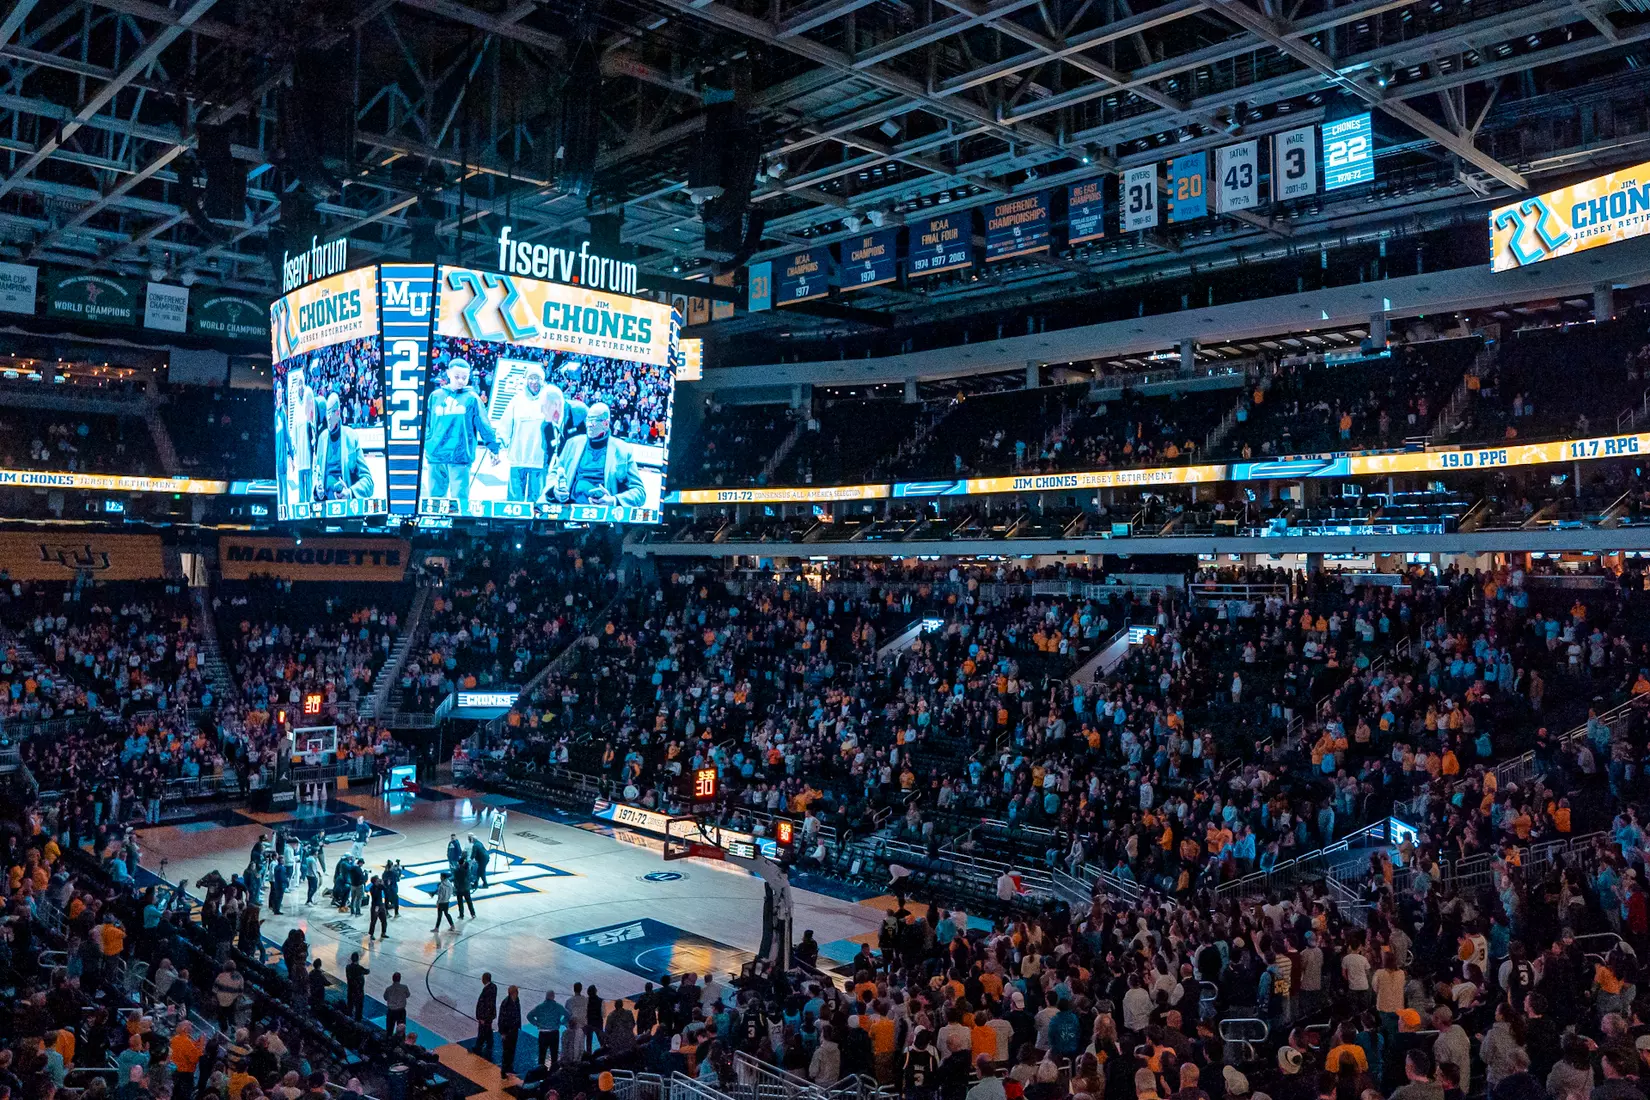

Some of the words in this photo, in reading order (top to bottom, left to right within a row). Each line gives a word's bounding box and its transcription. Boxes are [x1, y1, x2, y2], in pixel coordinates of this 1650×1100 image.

[1331, 120, 1360, 135] CHONES
[1286, 134, 1304, 145] WADE
[1229, 148, 1249, 159] TATUM
[1329, 136, 1367, 166] 22
[1180, 159, 1199, 171] LUCAS
[1285, 147, 1305, 179] 3
[1131, 170, 1150, 182] RIVERS
[1224, 163, 1253, 190] 43
[1337, 170, 1361, 183] 1970-72
[1073, 187, 1083, 197] BIG
[1083, 183, 1098, 194] EAST
[1177, 174, 1202, 201] 20
[1285, 183, 1308, 194] 2001-03
[1620, 179, 1636, 189] JIM
[1070, 191, 1101, 206] CHAMPIONS
[1129, 182, 1153, 214] 31
[1229, 196, 1250, 206] 1972-76
[995, 197, 1039, 217] CONFERENCE
[931, 219, 949, 232] NCAA
[988, 207, 1046, 230] CHAMPIONSHIPS
[922, 231, 940, 246] FINAL
[941, 228, 958, 241] FOUR
[1496, 197, 1571, 266] 22
[1574, 224, 1612, 239] JERSEY
[863, 236, 873, 248] NIT
[498, 226, 637, 294] fiserv.forum
[795, 253, 810, 265] NCAA
[851, 245, 885, 261] CHAMPIONS
[914, 258, 929, 270] 1974
[931, 255, 946, 266] 1977
[948, 251, 966, 263] 2003
[283, 235, 347, 293] fiserv.forum
[786, 261, 818, 277] CHAMPIONS
[13, 275, 27, 283] CUP
[860, 270, 876, 282] 1970
[752, 277, 768, 299] 31
[795, 286, 810, 297] 1977
[148, 293, 186, 306] CONFERENCE
[385, 280, 428, 317] MU
[595, 300, 610, 309] JIM
[692, 299, 705, 312] 14
[54, 301, 82, 311] WORLD
[85, 304, 131, 317] CHAMPIONS
[149, 302, 184, 313] CHAMPIONS
[299, 289, 361, 333] CHONES
[447, 271, 540, 342] 22
[543, 301, 652, 344] CHONES
[199, 320, 225, 331] WORLD
[226, 324, 267, 336] CHAMPIONS
[321, 321, 363, 338] RETIREMENT
[542, 332, 583, 344] JERSEY
[588, 338, 652, 355] RETIREMENT
[1570, 441, 1599, 458] 11.7
[1604, 437, 1639, 454] RPG
[1440, 453, 1474, 468] 19.0
[1479, 450, 1507, 466] PPG
[21, 473, 74, 485] CHONES
[79, 478, 114, 487] JERSEY
[118, 479, 178, 489] RETIREMENT
[1012, 479, 1033, 489] JIM
[1035, 475, 1078, 489] CHONES
[1082, 475, 1112, 484] JERSEY
[1116, 472, 1173, 483] RETIREMENT
[717, 491, 752, 501] 1971-72
[754, 491, 791, 499] CONSENSUS
[834, 489, 861, 497] SELECTION
[503, 505, 522, 515] 40
[581, 508, 598, 519] 23
[227, 545, 400, 565] MARQUETTE
[466, 694, 511, 705] CHONES
[305, 702, 319, 713] 30
[698, 770, 715, 781] 9:35
[695, 779, 713, 796] 30
[618, 808, 648, 825] 1971-72
[780, 832, 789, 840] 30
[1519, 971, 1529, 985] 3
[828, 1000, 836, 1010] 3
[748, 1026, 756, 1038] 3
[914, 1073, 924, 1087] 3
